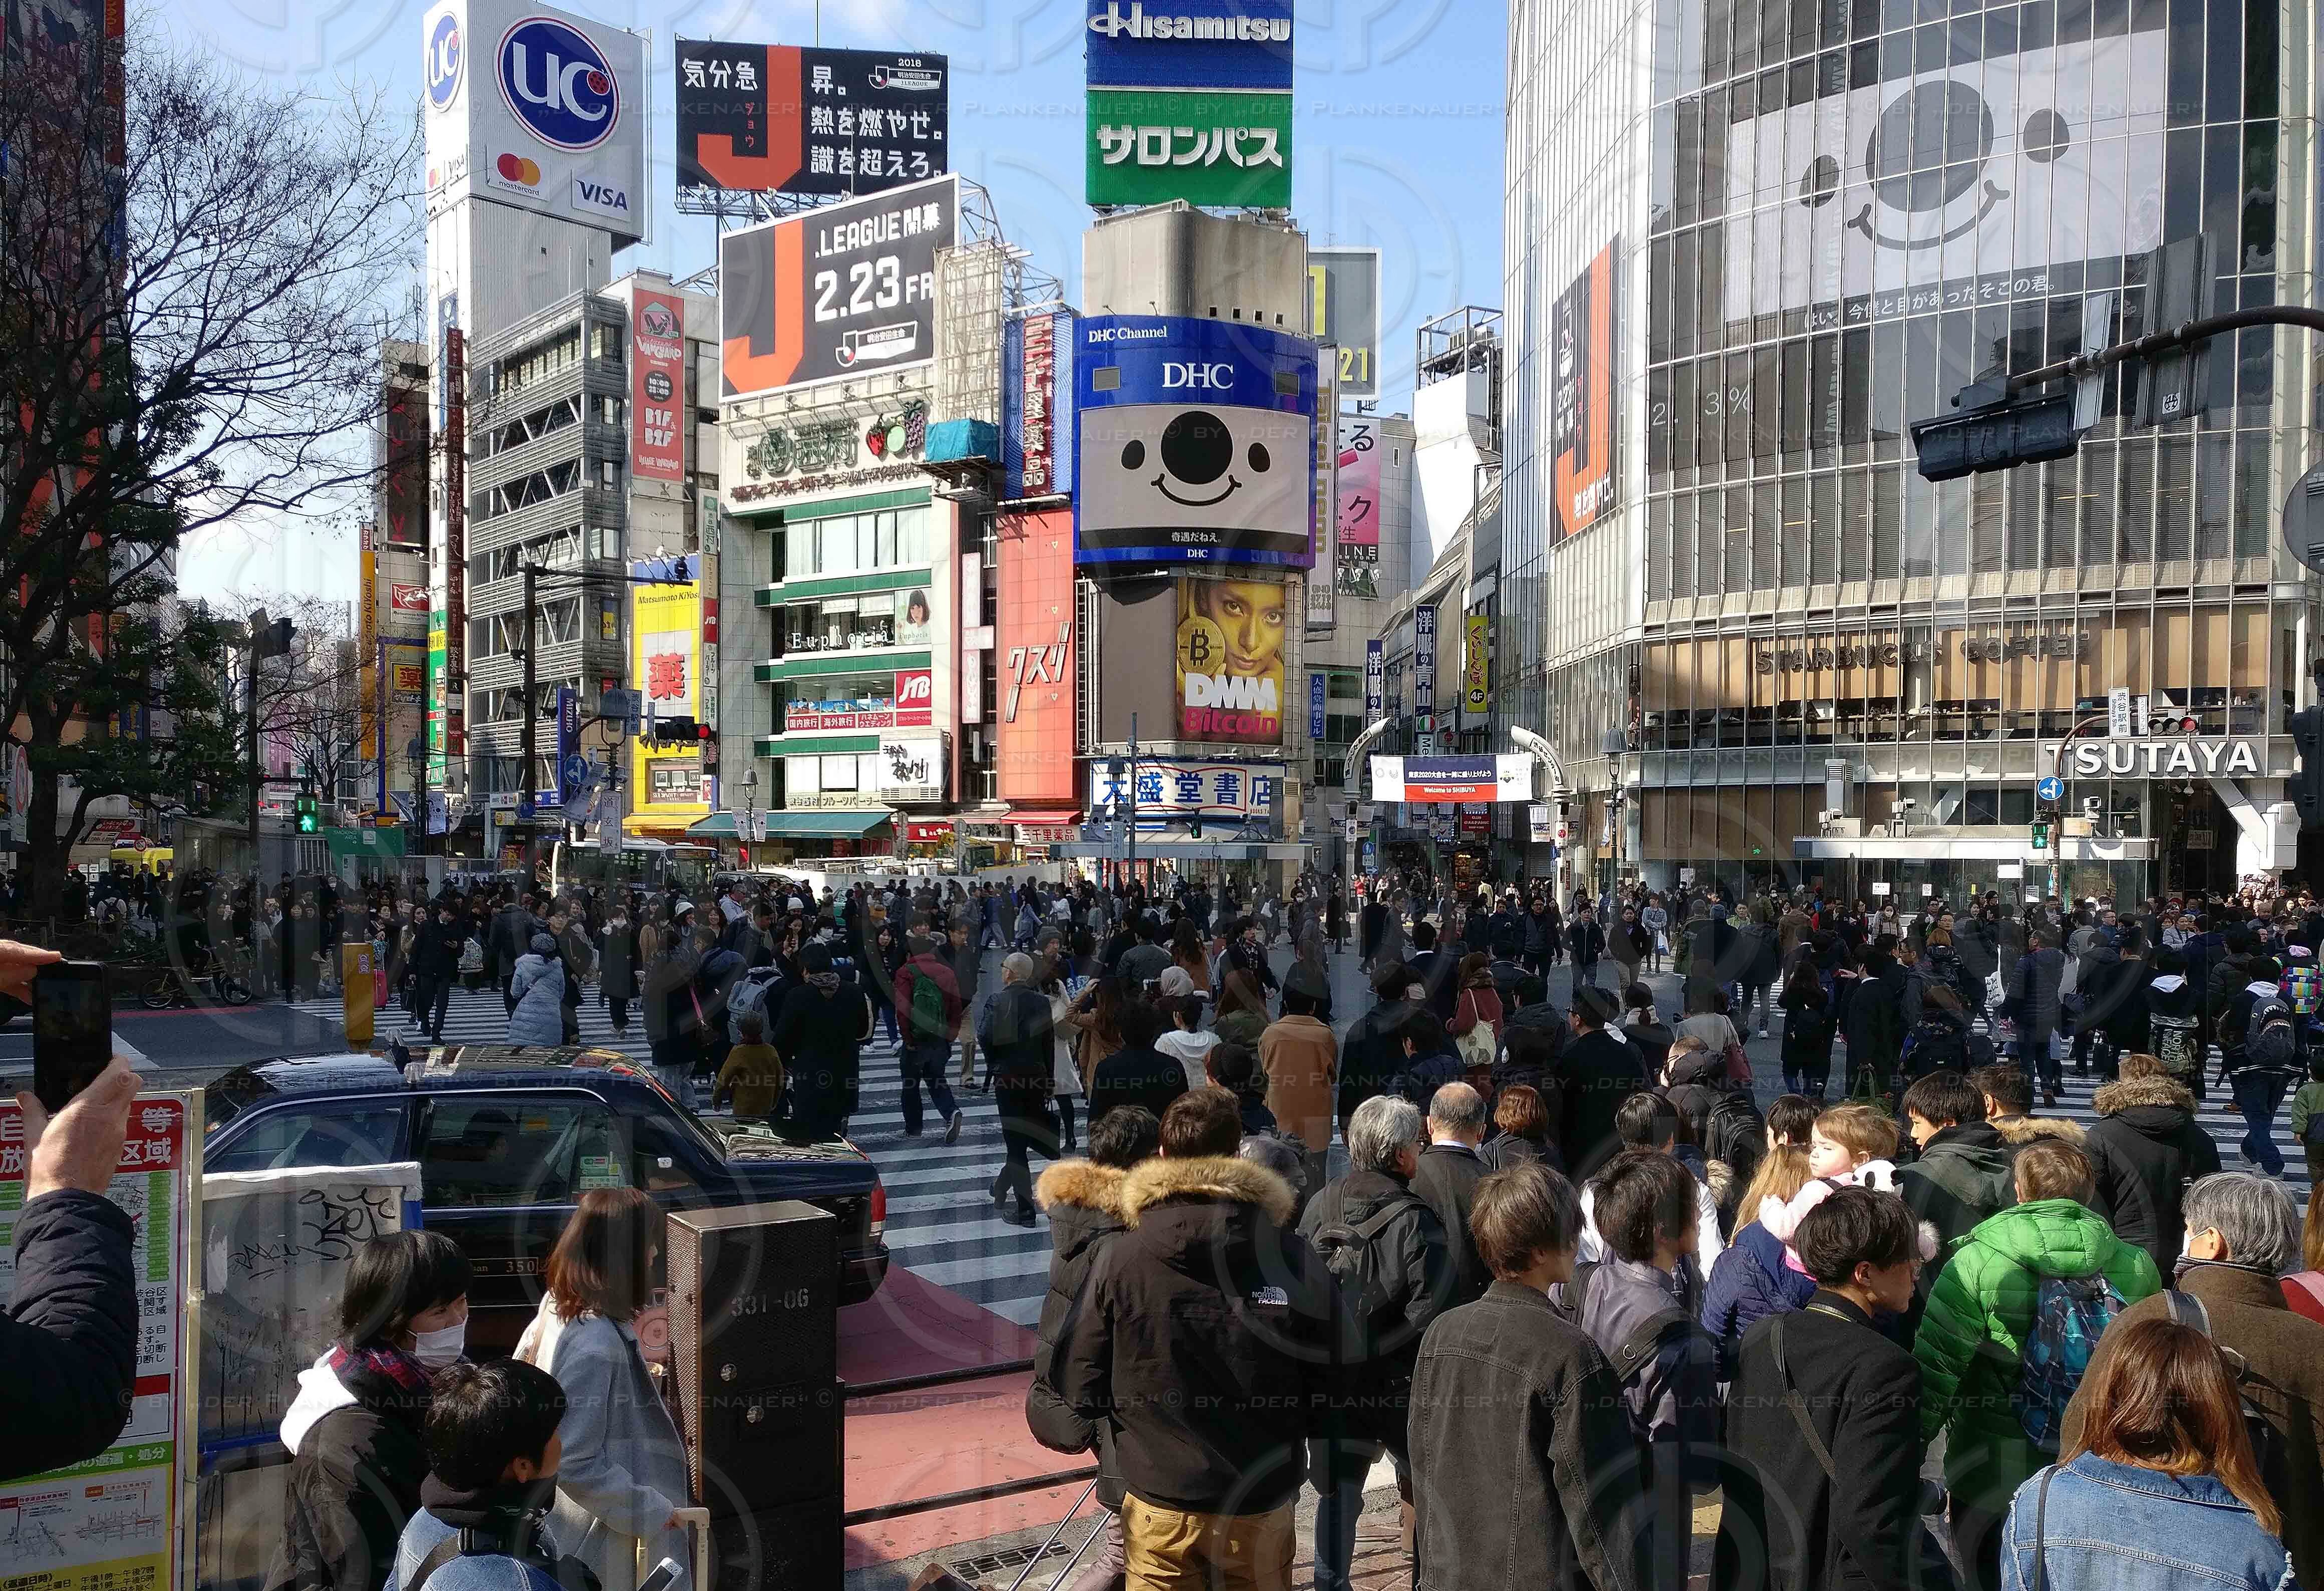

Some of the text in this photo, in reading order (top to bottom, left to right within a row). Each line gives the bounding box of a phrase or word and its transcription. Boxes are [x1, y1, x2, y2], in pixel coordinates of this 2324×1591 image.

[1088, 2, 1291, 41] Hisamitsu
[682, 58, 758, 92] 気分急
[899, 59, 922, 67] 2018
[810, 66, 846, 96] 昇。
[698, 45, 802, 191] J
[744, 102, 755, 149] ジョウ
[810, 106, 943, 140] 熱を燃やせ。
[810, 145, 941, 176] 識を超えろ。
[1096, 125, 1282, 168] サロンパス
[499, 181, 539, 196] mastercard
[576, 179, 628, 211] VISA
[815, 255, 901, 323] 2.23
[1849, 275, 2056, 321] 今僕と目があったそこの君。
[1088, 326, 1168, 343] DHC Channel
[1162, 362, 1234, 389] DHC
[1340, 348, 1368, 382] 21
[645, 407, 672, 426] B1F
[1023, 321, 1046, 487] 三千里薬品
[644, 427, 674, 447] B2F
[1171, 531, 1223, 544] 奇遇だねえ。
[1187, 548, 1209, 559] DHC
[638, 595, 678, 605] Matsumoto
[705, 616, 716, 625] JTB
[792, 620, 889, 650] Euphoria
[1006, 621, 1071, 722] クスリ
[1416, 611, 1433, 707] 洋服の青山
[1755, 640, 1943, 674] STARBUCKS
[648, 653, 687, 700] 薬
[897, 675, 931, 703] JTB
[1185, 672, 1277, 711] DMM
[1313, 677, 1322, 736] 大盛堂商事ビル
[1471, 691, 1483, 701] 4F
[565, 698, 573, 733] MIZUHO
[789, 717, 818, 728] 国内旅行
[823, 717, 853, 727] 海外旅行
[1185, 707, 1278, 735] Bitcoin
[2117, 692, 2127, 733] 渋谷駅前
[1421, 737, 1431, 757] Me
[2045, 740, 2258, 774] TSUTAYA
[1102, 772, 1271, 807] 大盛堂書店
[1022, 829, 1075, 842] 三千里薬品
[141, 1107, 173, 1133] 等
[117, 1137, 172, 1166] 区域
[506, 1261, 535, 1273] 350
